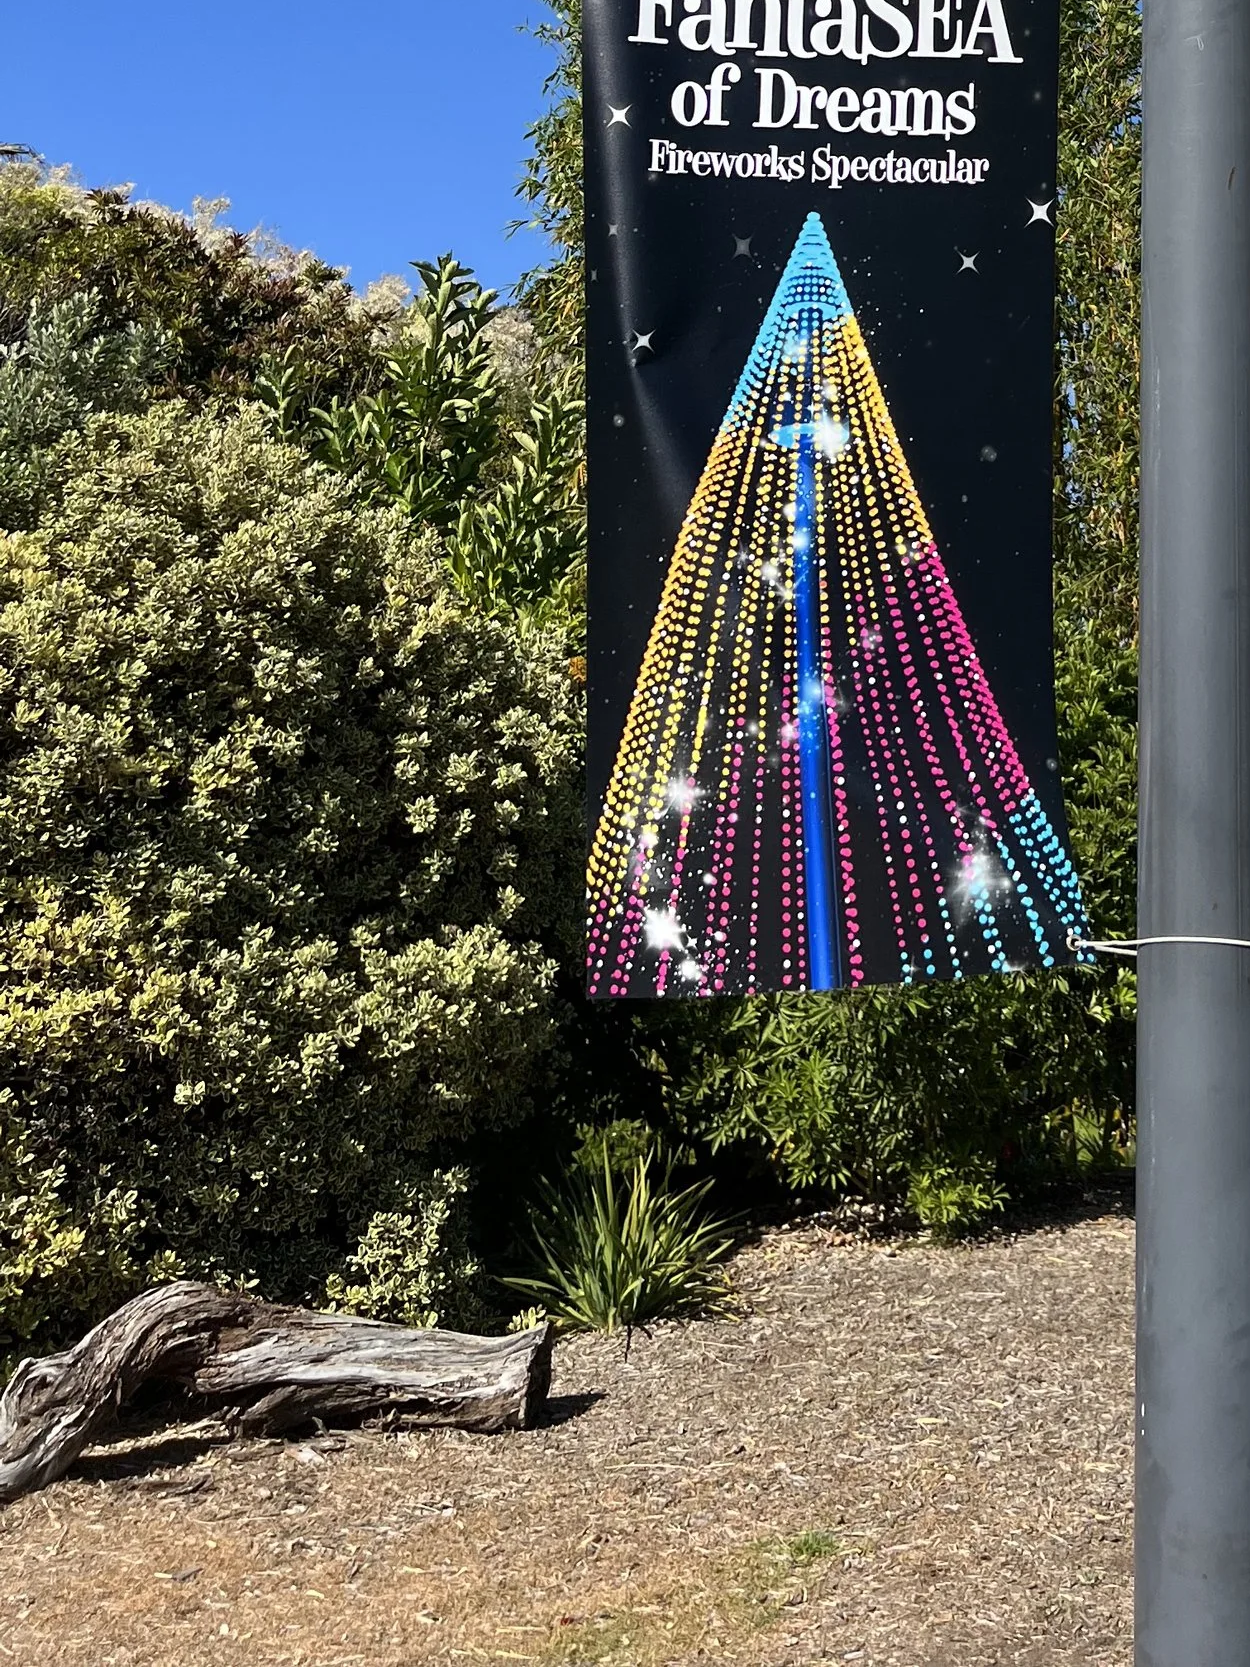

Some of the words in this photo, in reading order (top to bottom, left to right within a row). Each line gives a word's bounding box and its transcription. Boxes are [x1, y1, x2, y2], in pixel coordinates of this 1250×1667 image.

[670, 62, 742, 127] of
[751, 67, 976, 142] Dreams
[647, 138, 806, 183] Fireworks
[811, 142, 990, 189] Spectacular
